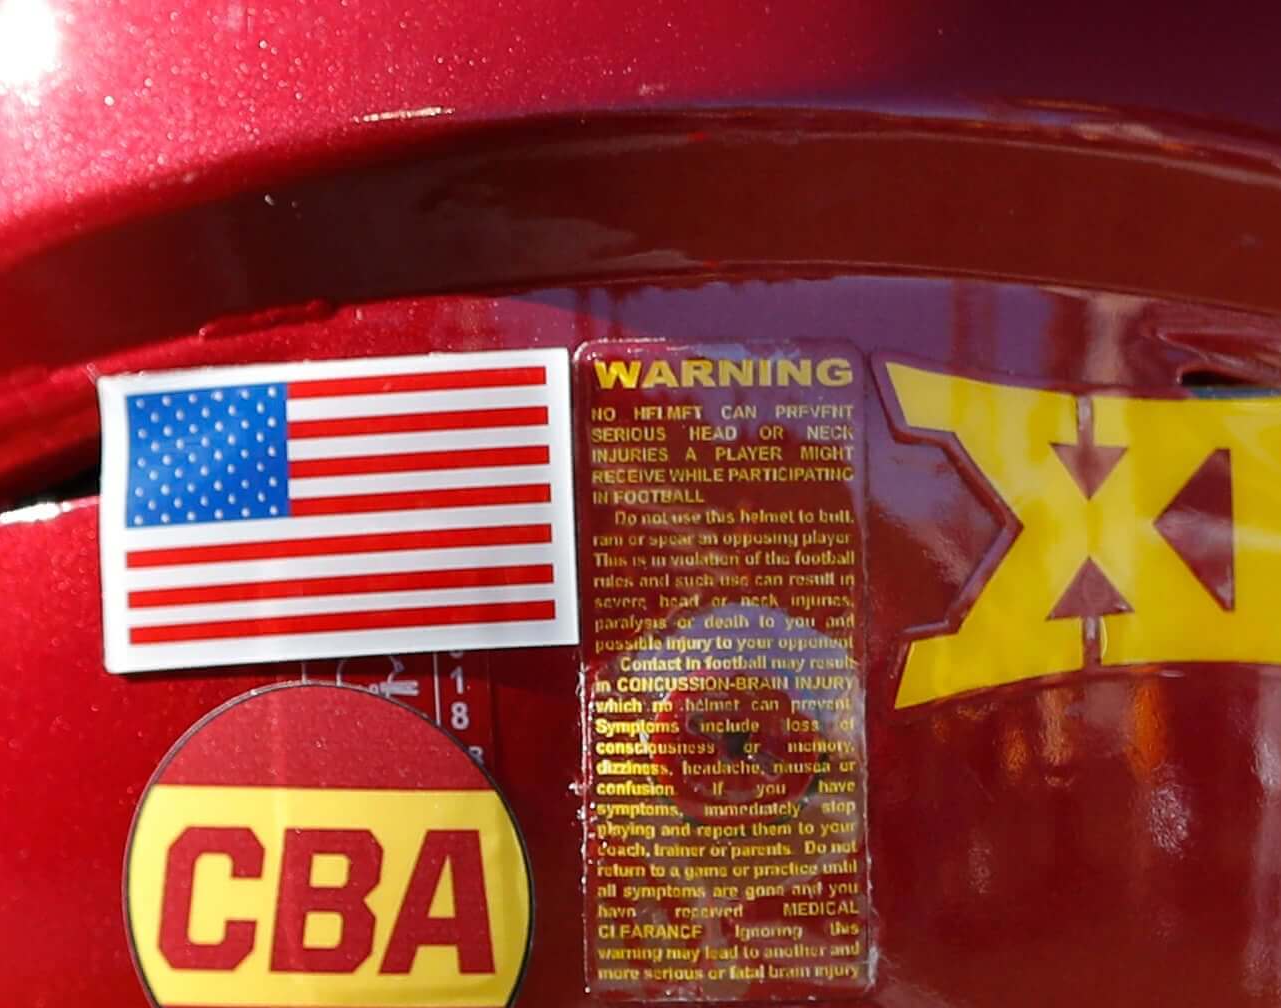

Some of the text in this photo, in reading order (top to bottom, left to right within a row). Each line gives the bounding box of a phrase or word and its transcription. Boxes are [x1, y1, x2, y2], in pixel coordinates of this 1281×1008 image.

[595, 357, 853, 389] WARNING
[592, 407, 616, 422] NO
[721, 404, 757, 420] CAN
[775, 404, 853, 419] PREVENT
[591, 425, 853, 443] SERIOUS HEAD OR NECK
[592, 445, 853, 463] INJURIES A PLAYER MIGHT
[592, 467, 854, 484] RECEIVE WHILE PARTICIPATING
[593, 491, 608, 505] IN
[615, 510, 637, 526] Do
[641, 511, 668, 525] not
[670, 513, 702, 525] use
[705, 510, 735, 525] this
[740, 508, 794, 524] helmet
[799, 509, 814, 523] to
[593, 535, 623, 547] ram
[628, 534, 645, 546] or
[649, 533, 692, 549] spear
[698, 533, 718, 546] an
[723, 532, 798, 548] opposing
[593, 549, 855, 568] This is in violation of the football
[593, 571, 856, 589] rules and such use can result in
[594, 596, 646, 609] severe
[659, 593, 700, 608] head
[711, 595, 728, 608] or
[740, 593, 780, 608] neck
[594, 612, 856, 634] paralysis or death to you and
[595, 633, 663, 654] possible
[666, 635, 712, 654] injury
[716, 634, 733, 650] to
[736, 636, 774, 653] your
[620, 654, 855, 674] Contact in football may result
[594, 674, 852, 693] in CONCUSSION-BRAIN INJURY
[595, 697, 643, 713] which
[651, 699, 673, 713] no
[685, 697, 741, 712] helmet
[750, 699, 780, 713] can
[595, 716, 855, 738] Symptoms include loss of
[595, 740, 717, 756] consciousness
[742, 742, 761, 755] or
[772, 761, 831, 774] nausea
[838, 760, 857, 774] or
[712, 780, 725, 797] If
[755, 782, 787, 799] you
[817, 778, 857, 795] have
[703, 800, 801, 818] immediately
[820, 799, 857, 816] stop
[596, 821, 857, 841] playing and report them to your
[653, 842, 706, 858] trainer
[709, 845, 729, 858] or
[804, 839, 827, 855] Do
[831, 839, 858, 854] not
[597, 859, 858, 881] return to a game or practice until
[158, 825, 496, 976] CBA
[597, 881, 859, 902] all symptoms are gone and you
[598, 899, 861, 919] have received MEDICAL
[734, 923, 804, 942] Ignoring
[830, 920, 861, 937] this
[597, 939, 861, 963] warning may lead to another and
[597, 967, 640, 981] more
[643, 966, 704, 982] serious
[708, 967, 725, 981] or
[729, 964, 765, 981] fatal
[768, 963, 811, 979] brain
